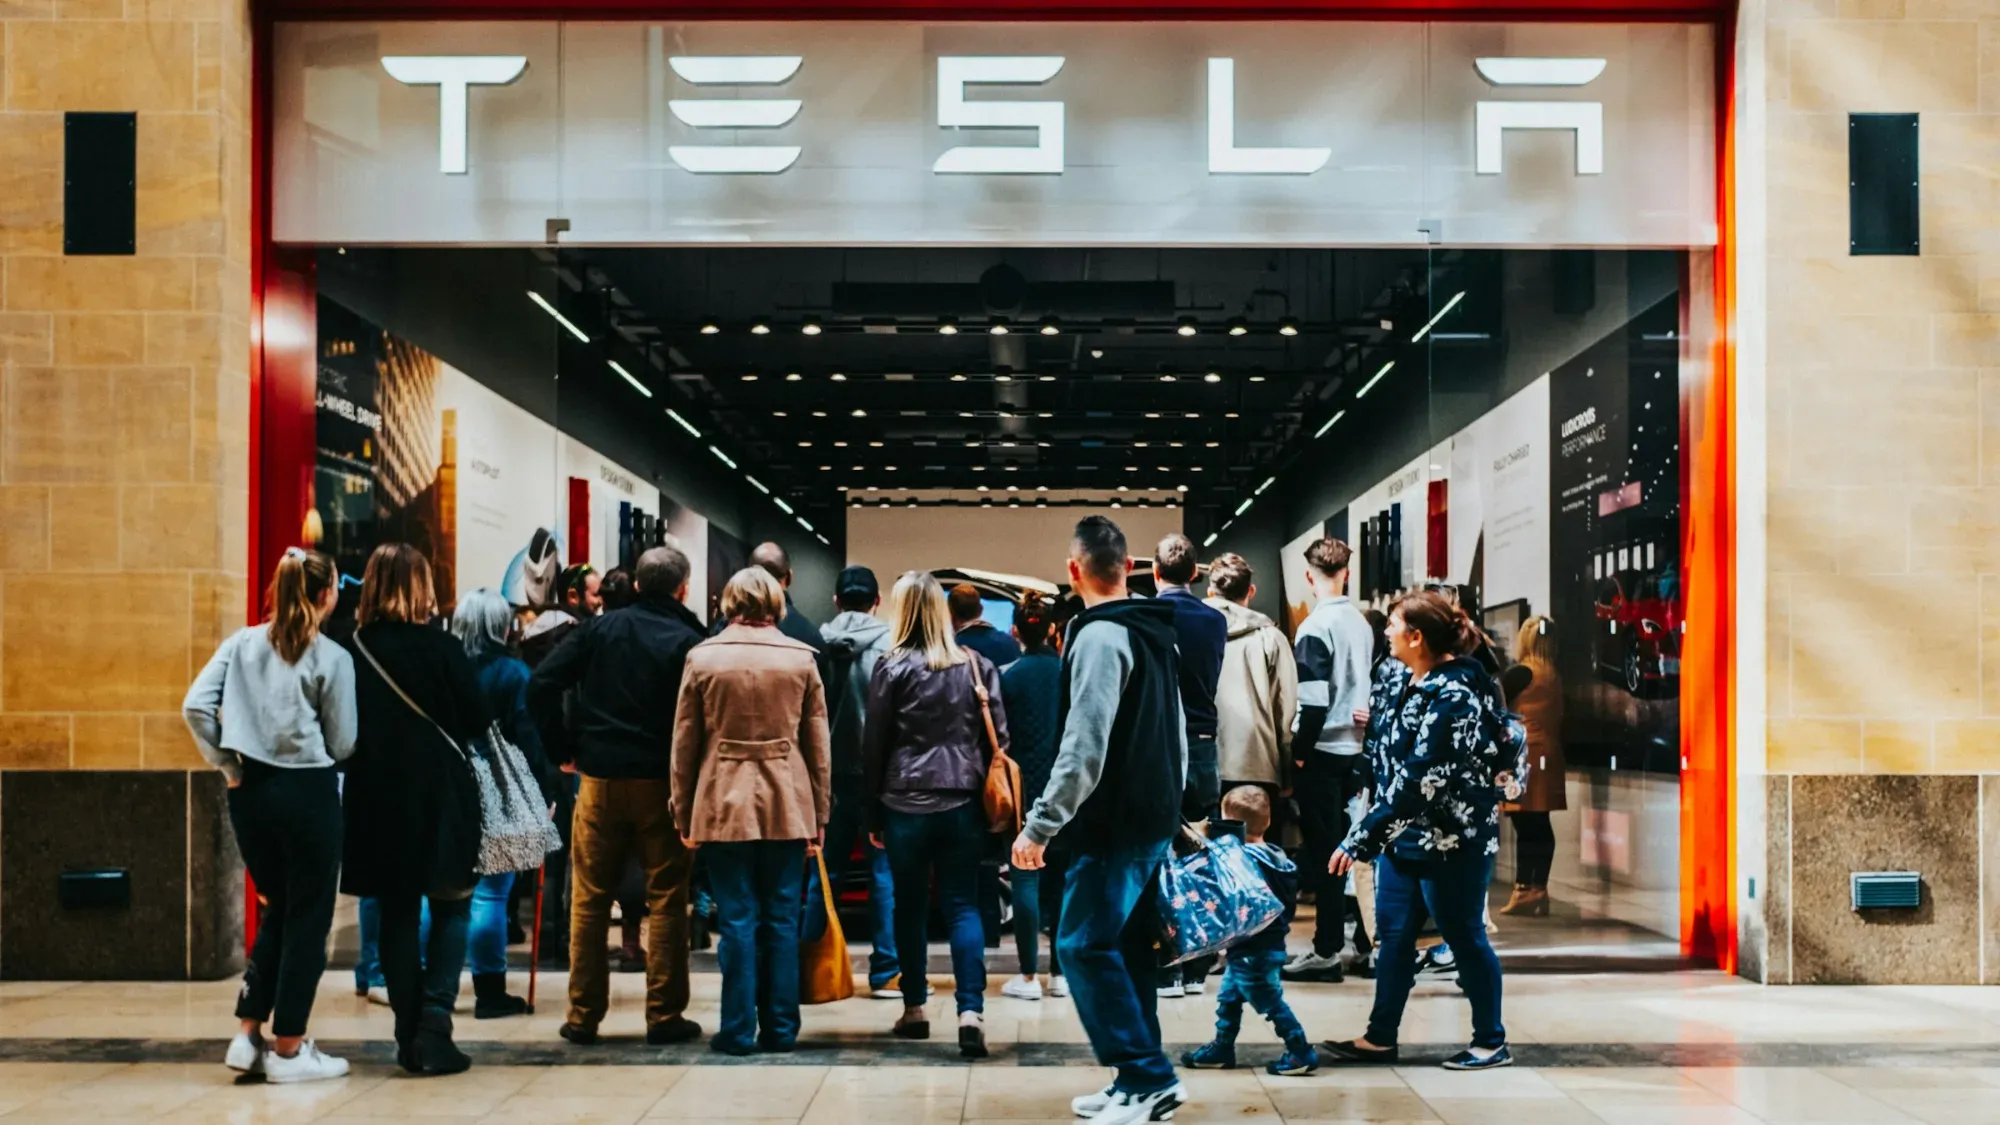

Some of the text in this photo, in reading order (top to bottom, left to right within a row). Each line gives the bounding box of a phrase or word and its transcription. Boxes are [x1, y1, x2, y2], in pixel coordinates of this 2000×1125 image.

[381, 56, 1607, 174] TESLA
[316, 389, 382, 432] L-WHEEL DRIVE
[1562, 423, 1607, 457] PERFORMANCE
